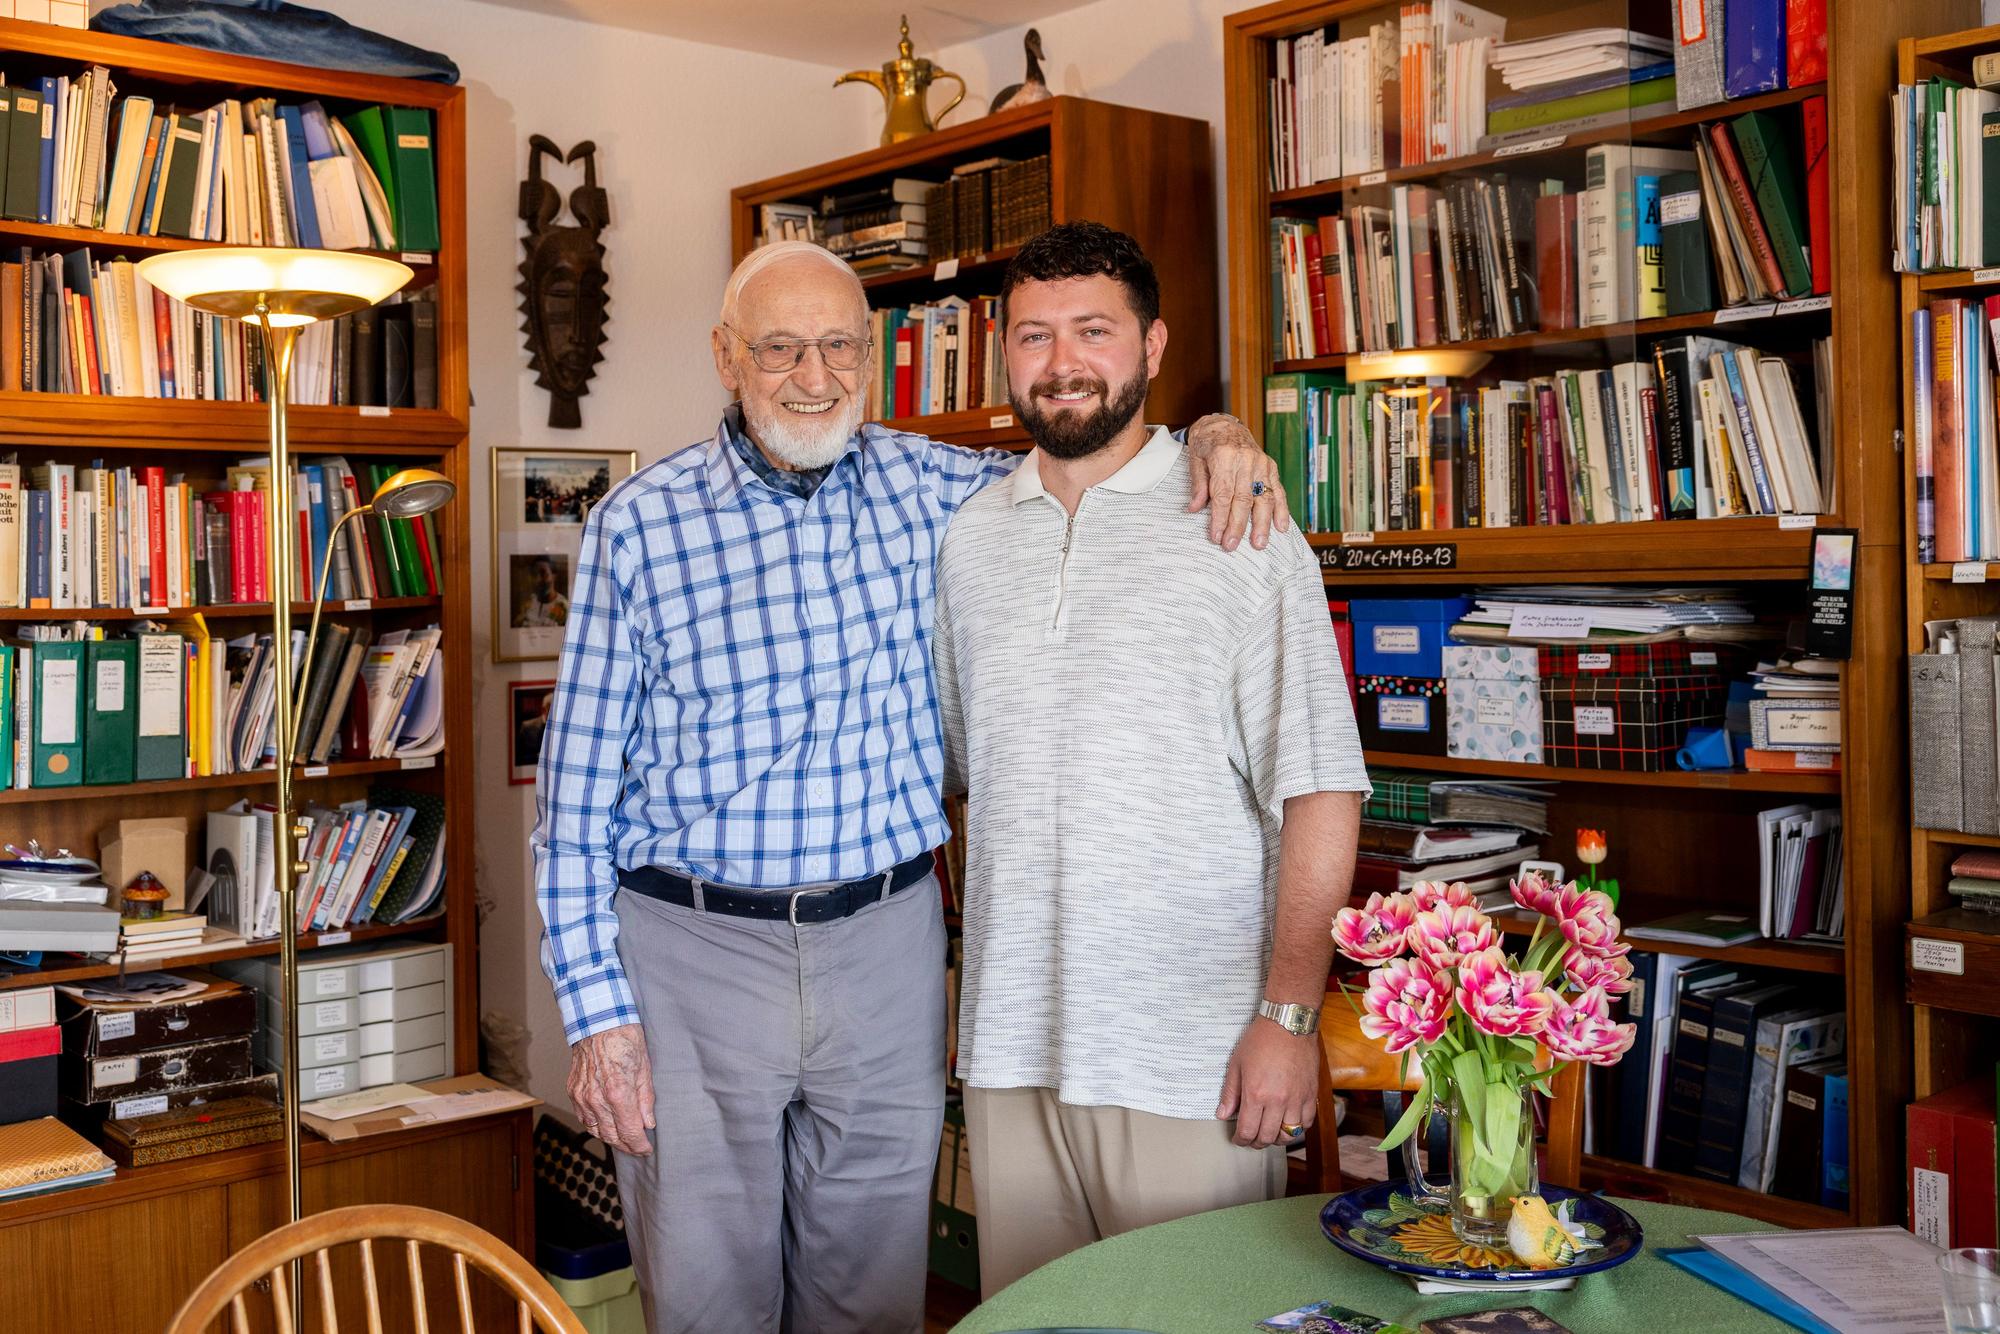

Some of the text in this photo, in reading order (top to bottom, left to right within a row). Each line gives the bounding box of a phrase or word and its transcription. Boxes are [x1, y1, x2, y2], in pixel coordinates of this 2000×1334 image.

[1936, 314, 1953, 382] SOUTH AFRICA
[1666, 369, 1679, 466] NELSON MANDELA
[1390, 454, 1400, 467] und
[1389, 468, 1401, 504] Deutschen
[1390, 505, 1402, 516] Die
[154, 511, 162, 553] Deutschland,
[20, 700, 28, 728] BESTES
[359, 826, 382, 857] China
